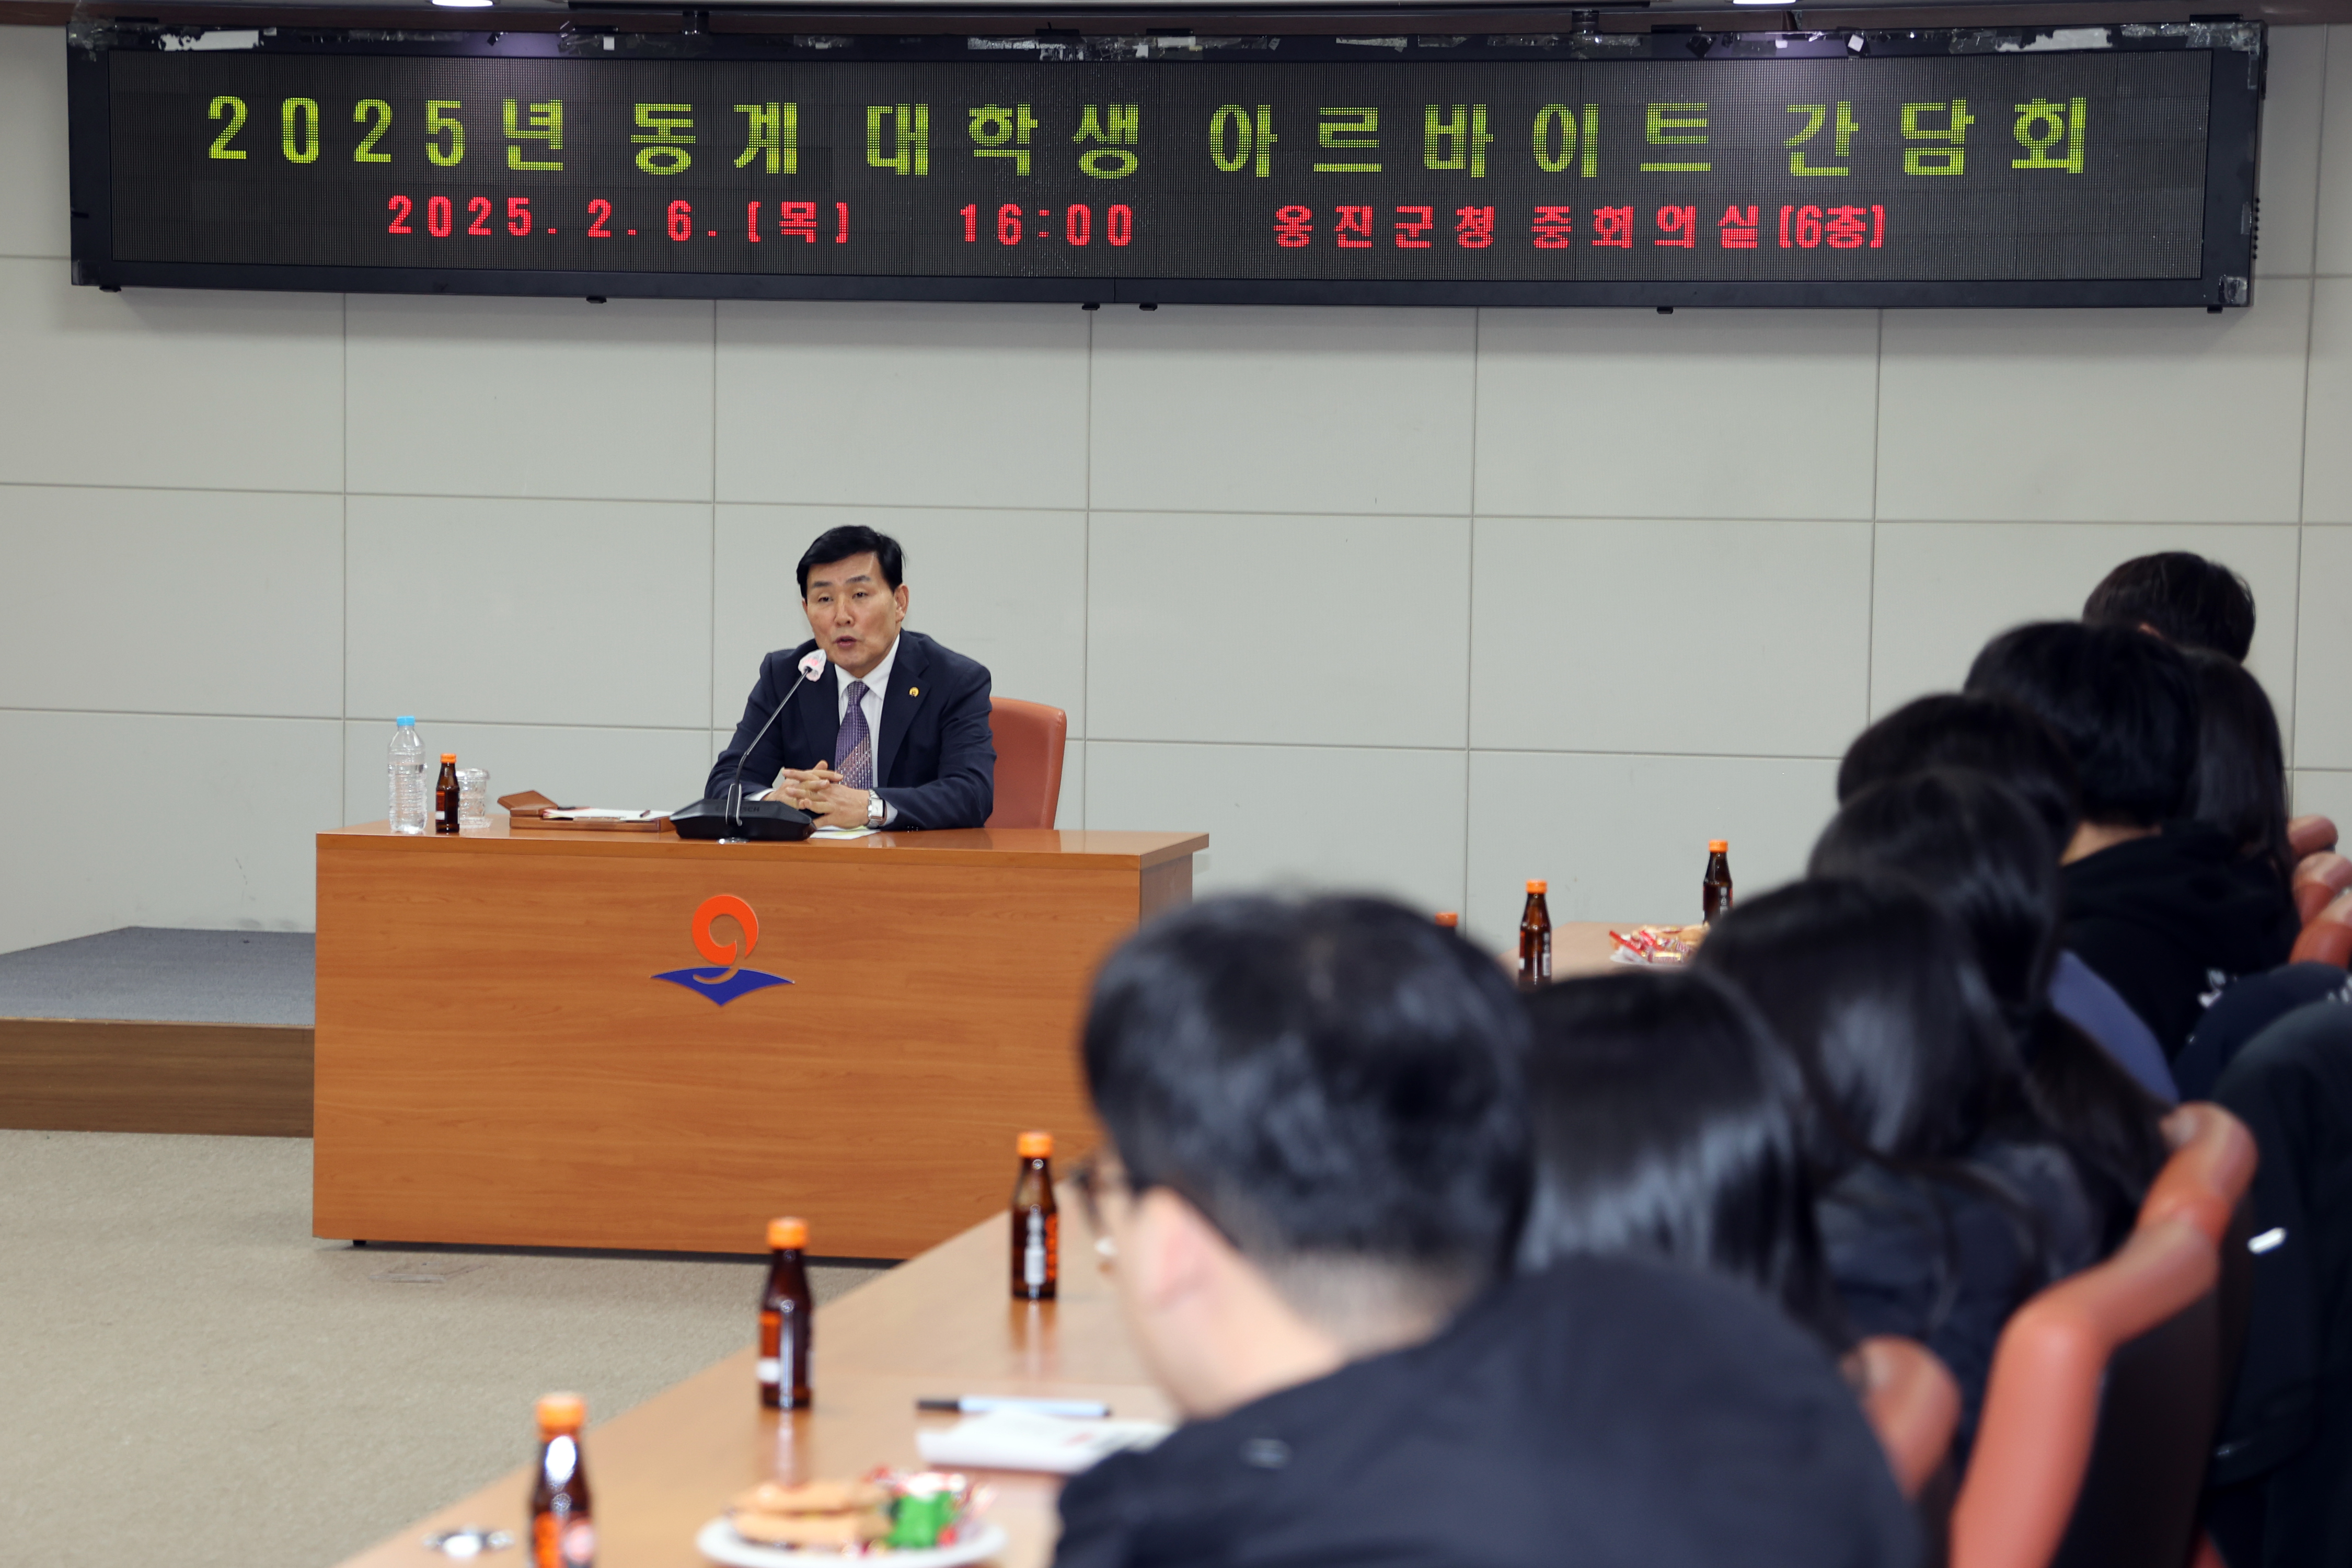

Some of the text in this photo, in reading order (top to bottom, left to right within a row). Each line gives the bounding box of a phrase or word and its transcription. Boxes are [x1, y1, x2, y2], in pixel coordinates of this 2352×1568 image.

[209, 95, 2086, 179] 2025년 동계 대학생 아르바이트 간담회
[960, 203, 1132, 246] 16:00
[1272, 204, 1495, 248] 옹진군청
